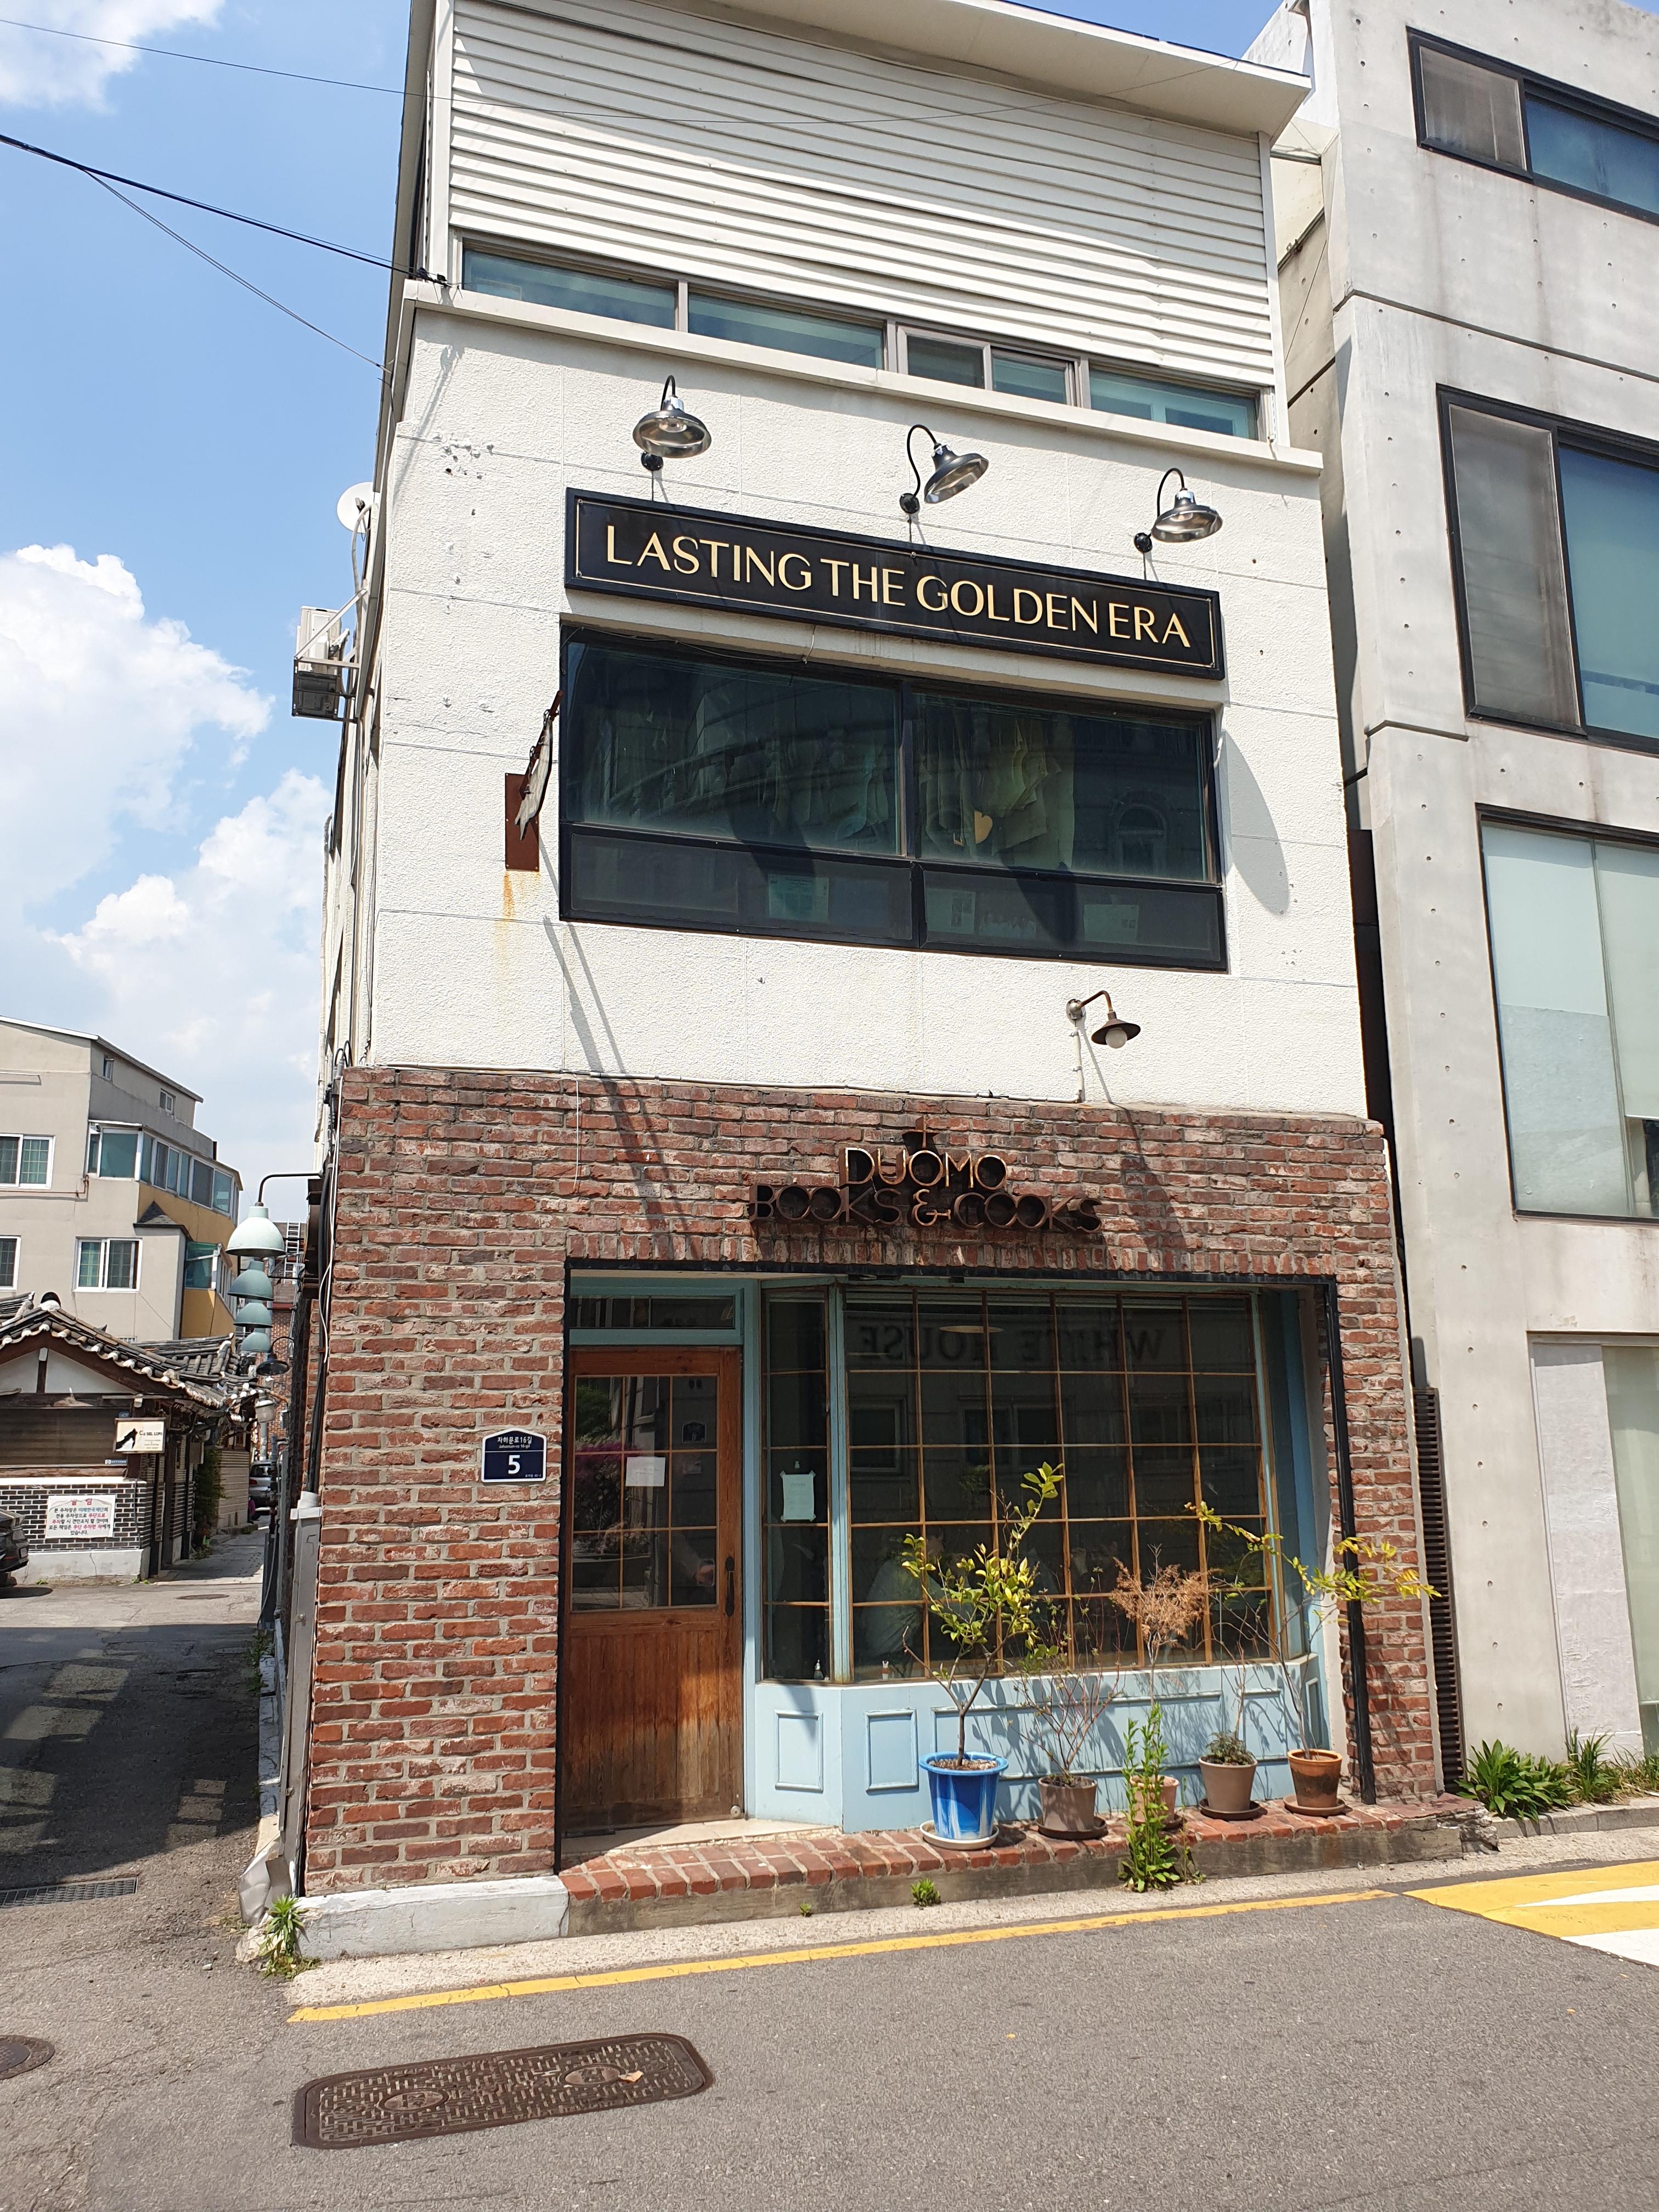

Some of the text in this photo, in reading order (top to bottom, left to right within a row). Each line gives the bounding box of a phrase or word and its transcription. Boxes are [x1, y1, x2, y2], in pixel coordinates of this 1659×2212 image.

[607, 525, 1191, 648] LASTING THE GOLDEN ERA
[840, 1147, 1008, 1190] DUOMO
[749, 1183, 1103, 1233] BOOKS & COOKS
[508, 1454, 521, 1474] 5
